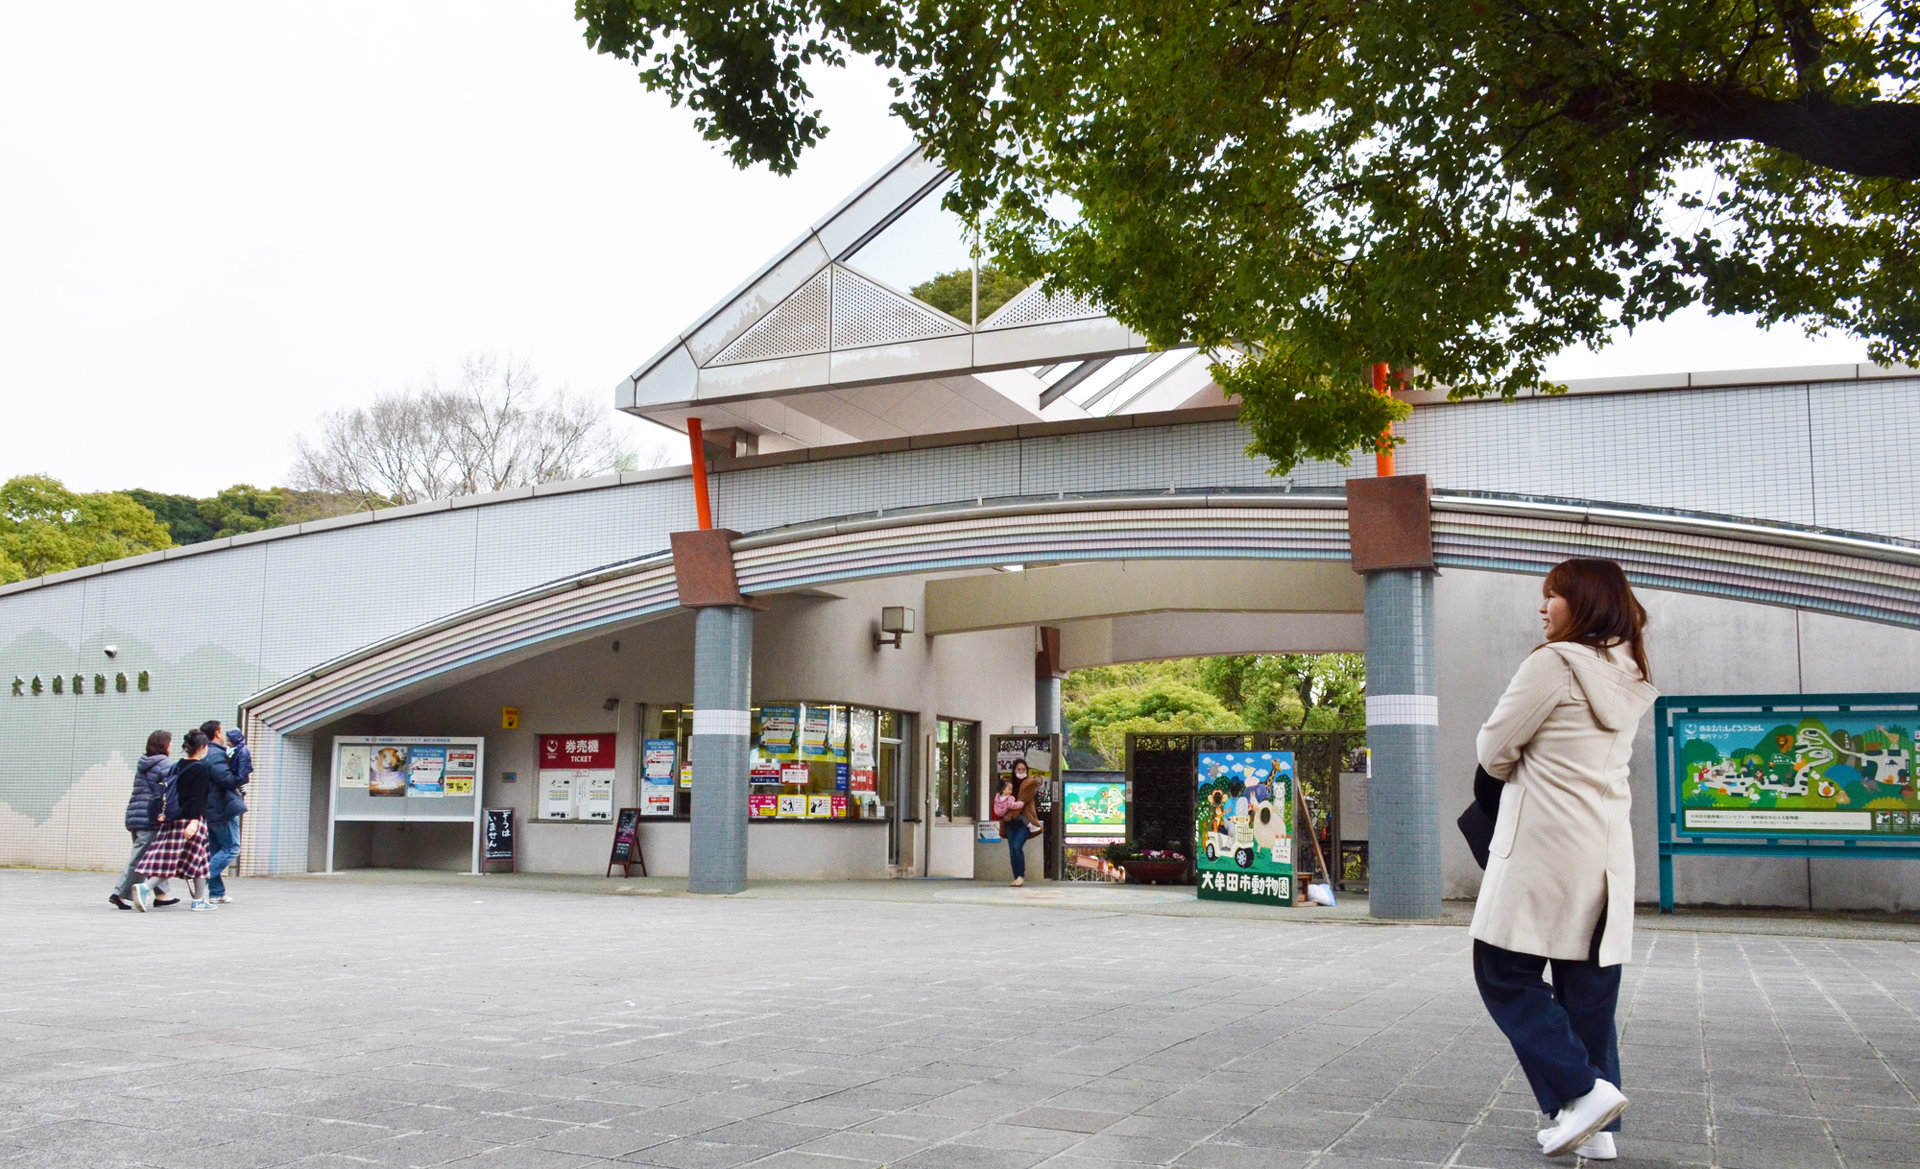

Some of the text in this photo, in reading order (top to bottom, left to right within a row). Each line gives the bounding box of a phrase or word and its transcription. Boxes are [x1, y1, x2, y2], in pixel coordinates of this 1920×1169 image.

[565, 739, 599, 753] 券売機
[571, 755, 592, 763] TICKET
[489, 816, 497, 848] いません
[502, 811, 511, 837] ぞうは
[1201, 871, 1290, 899] 大牟田市動物園
